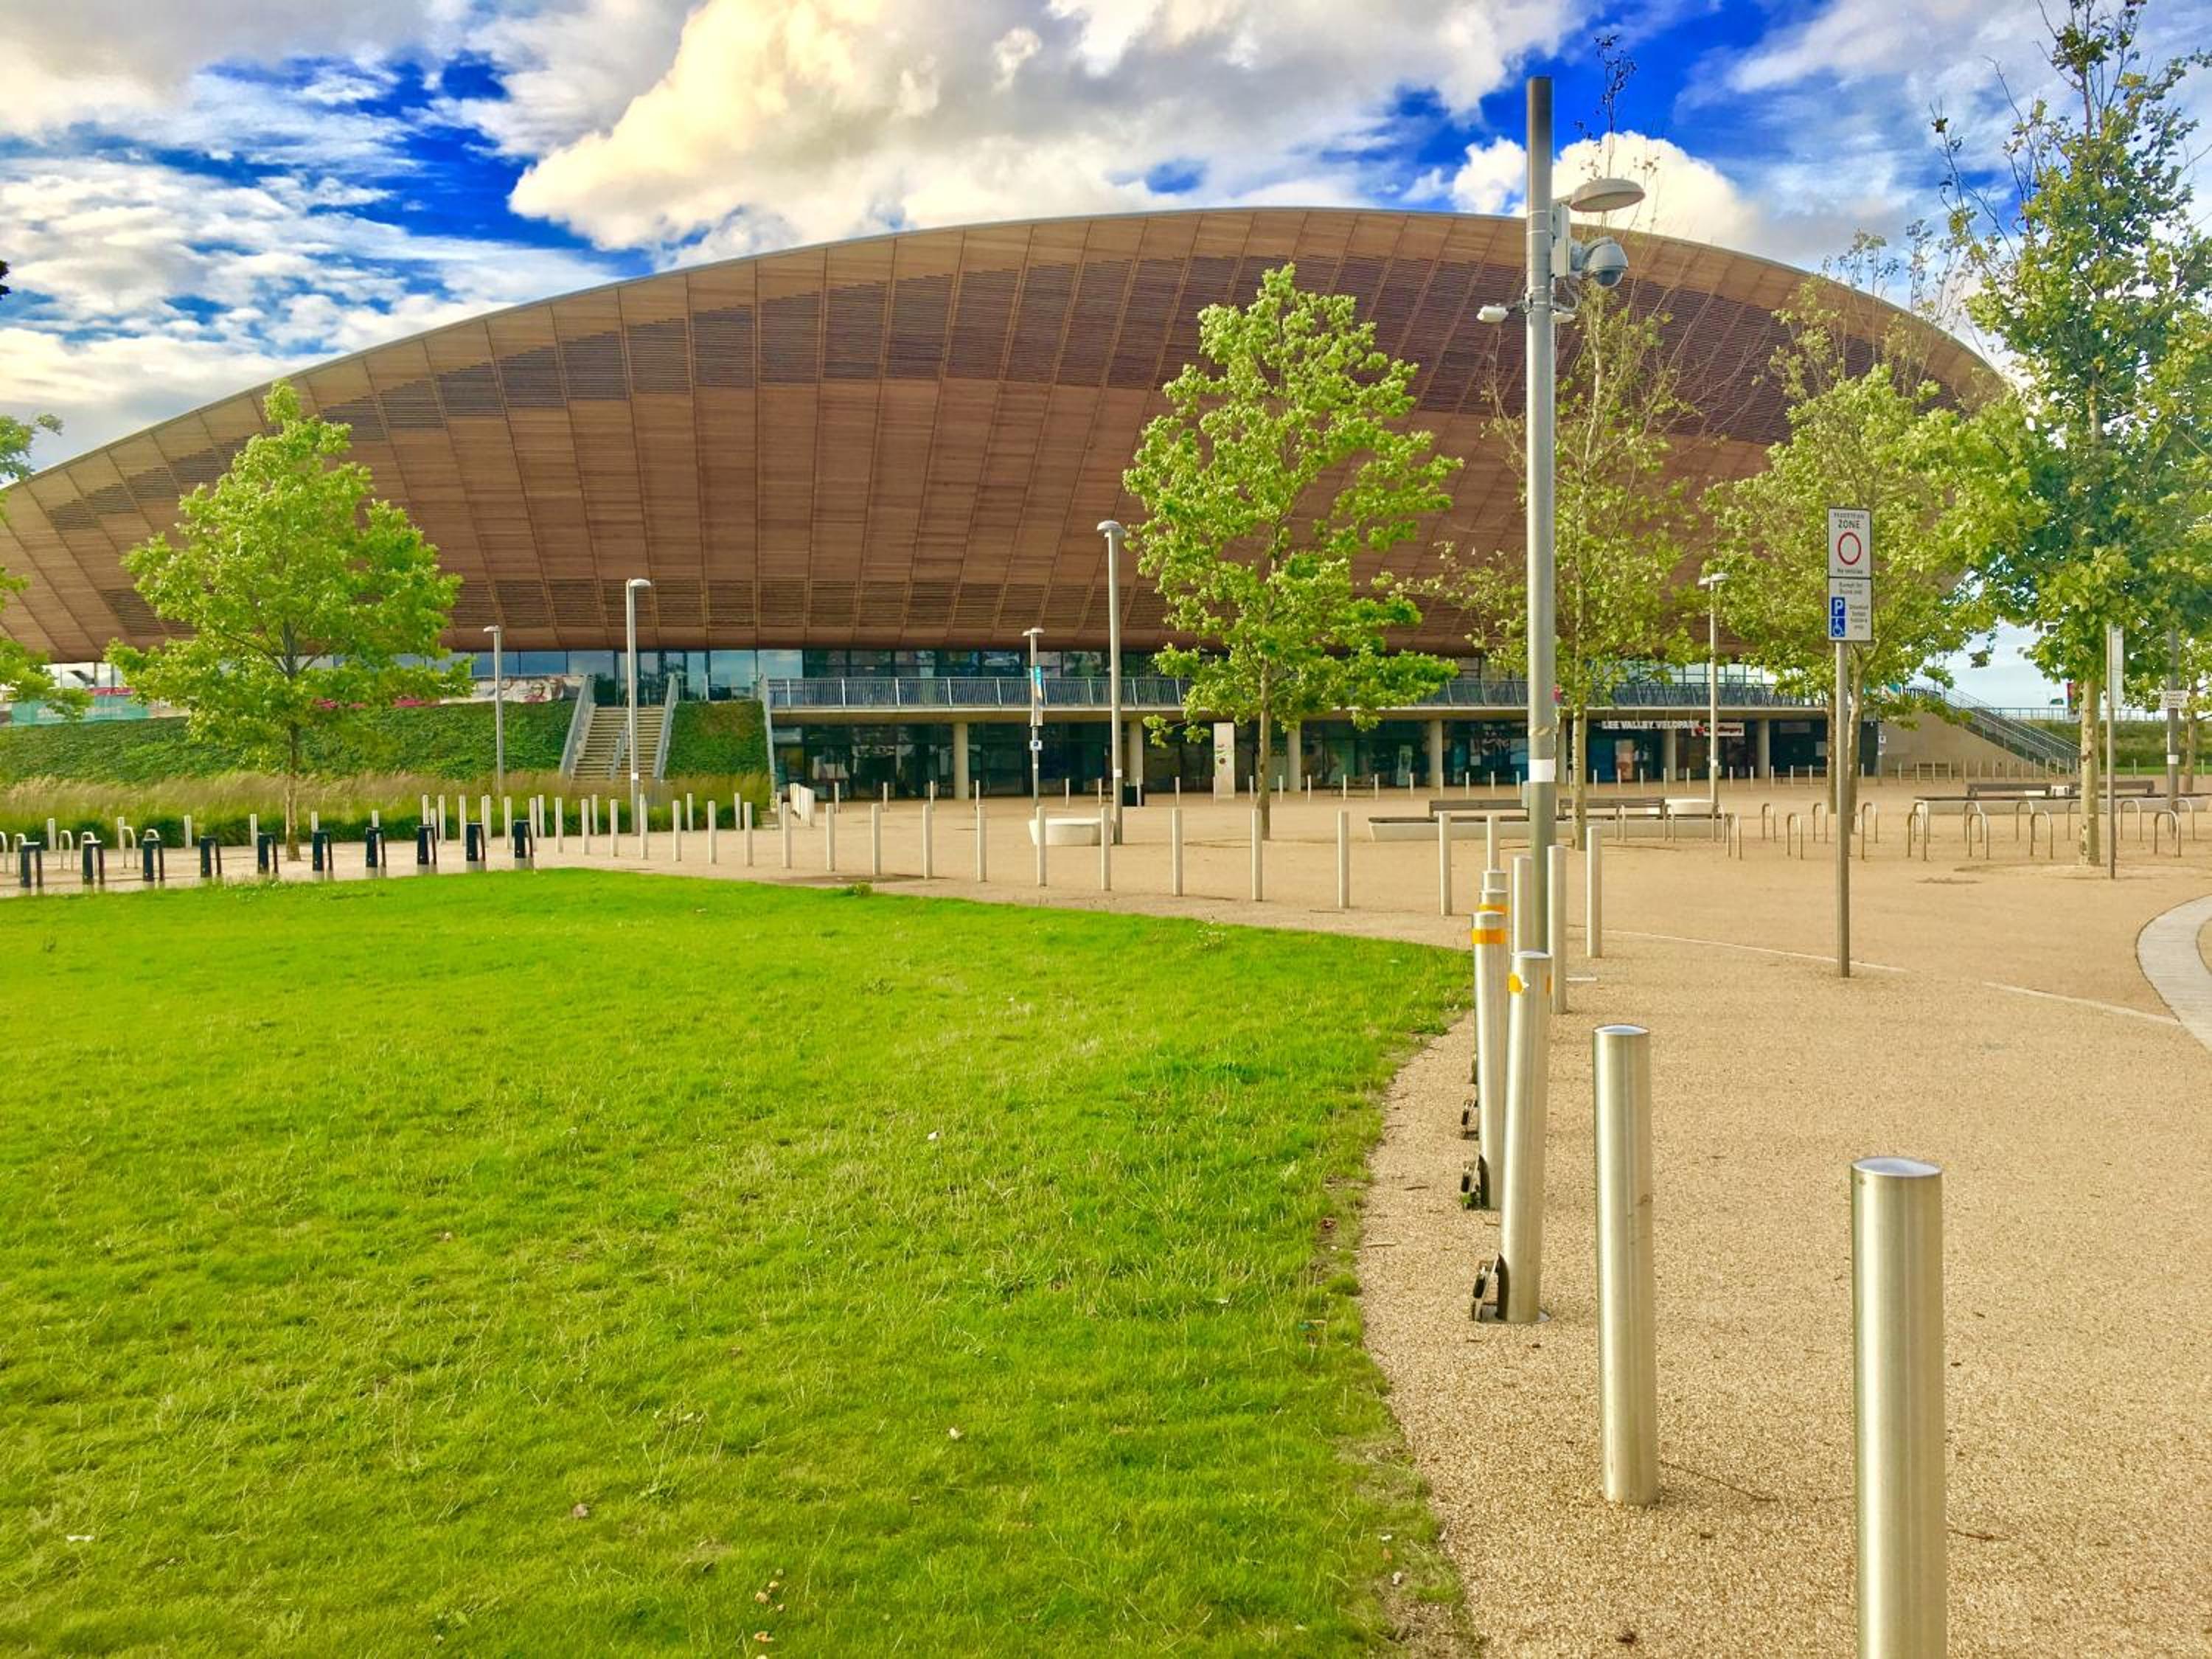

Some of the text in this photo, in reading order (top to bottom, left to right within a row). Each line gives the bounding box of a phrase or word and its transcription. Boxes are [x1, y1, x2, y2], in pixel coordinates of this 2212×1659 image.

[1838, 518, 1860, 529] ZONE
[1834, 599, 1843, 615] P
[1602, 720, 1619, 729] LEE
[1622, 720, 1653, 729] VALLEY
